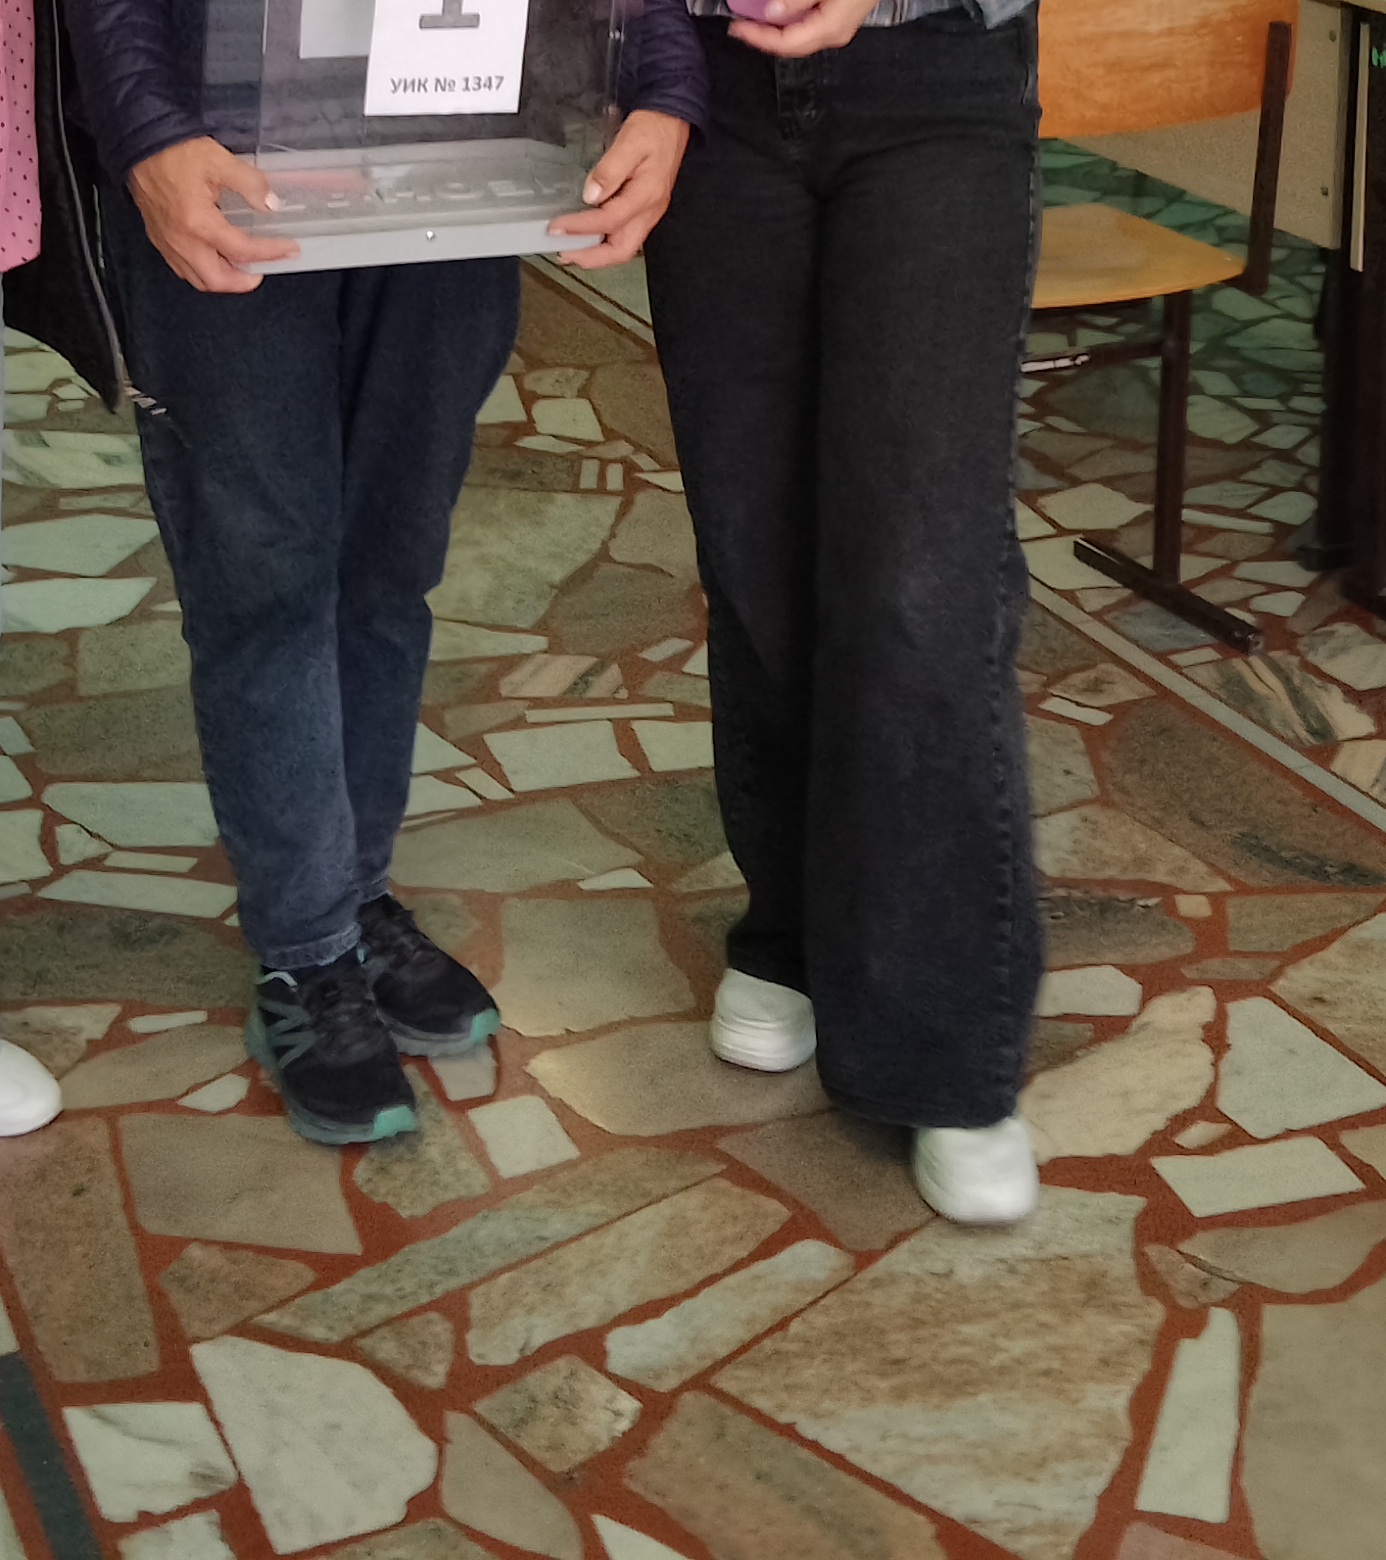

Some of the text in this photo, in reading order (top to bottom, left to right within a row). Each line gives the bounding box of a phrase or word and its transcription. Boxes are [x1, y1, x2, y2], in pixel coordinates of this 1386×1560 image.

[390, 75, 505, 94] УИК № 1347
